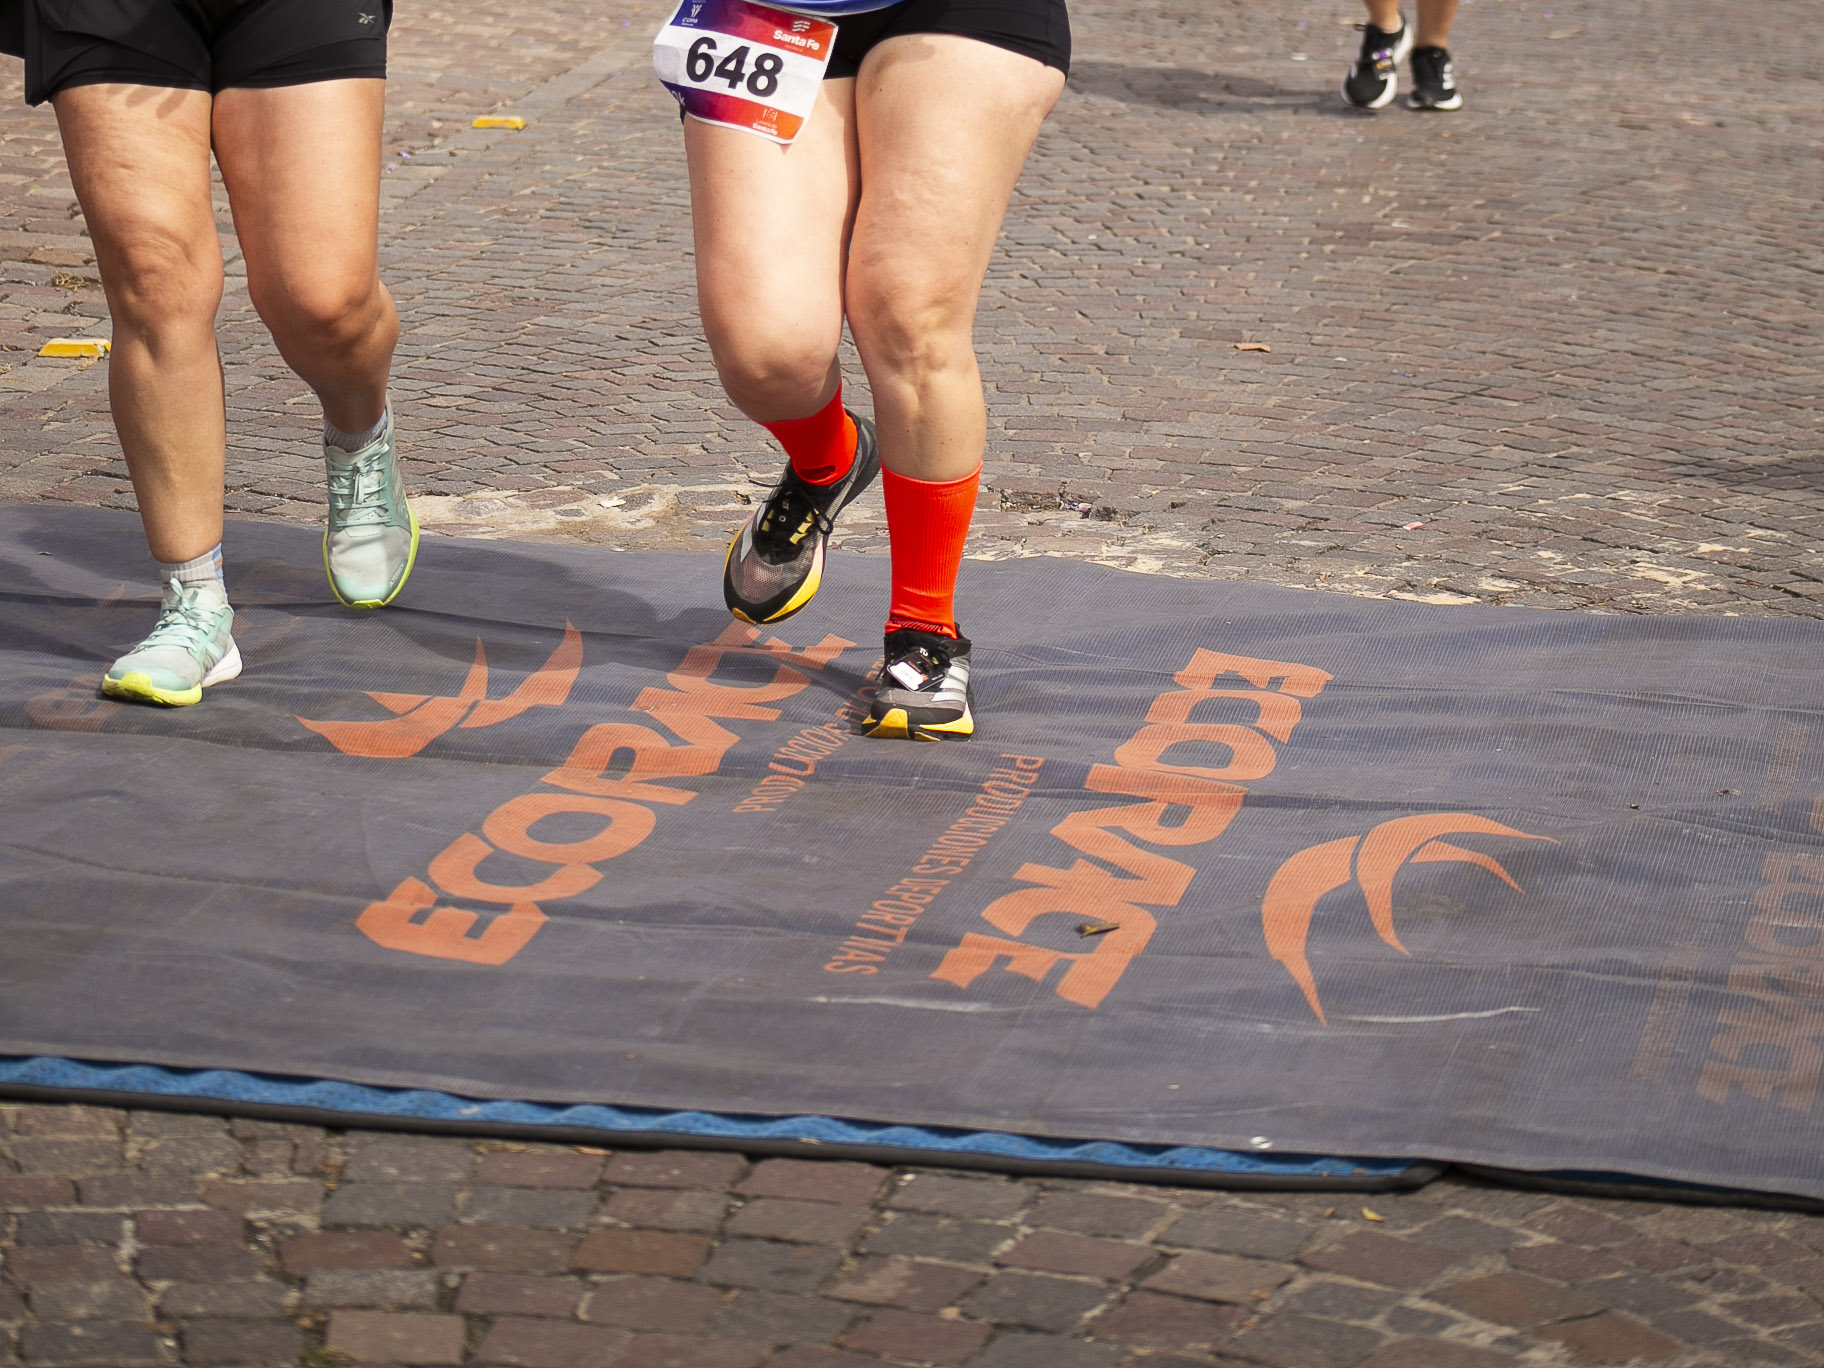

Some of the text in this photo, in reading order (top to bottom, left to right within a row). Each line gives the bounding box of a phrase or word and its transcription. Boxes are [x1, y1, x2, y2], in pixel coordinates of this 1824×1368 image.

[686, 36, 783, 97] 648
[773, 30, 807, 47] Santa
[806, 38, 820, 51] Fe
[355, 619, 857, 966] ECORACE
[929, 647, 1335, 1010] ECORACE
